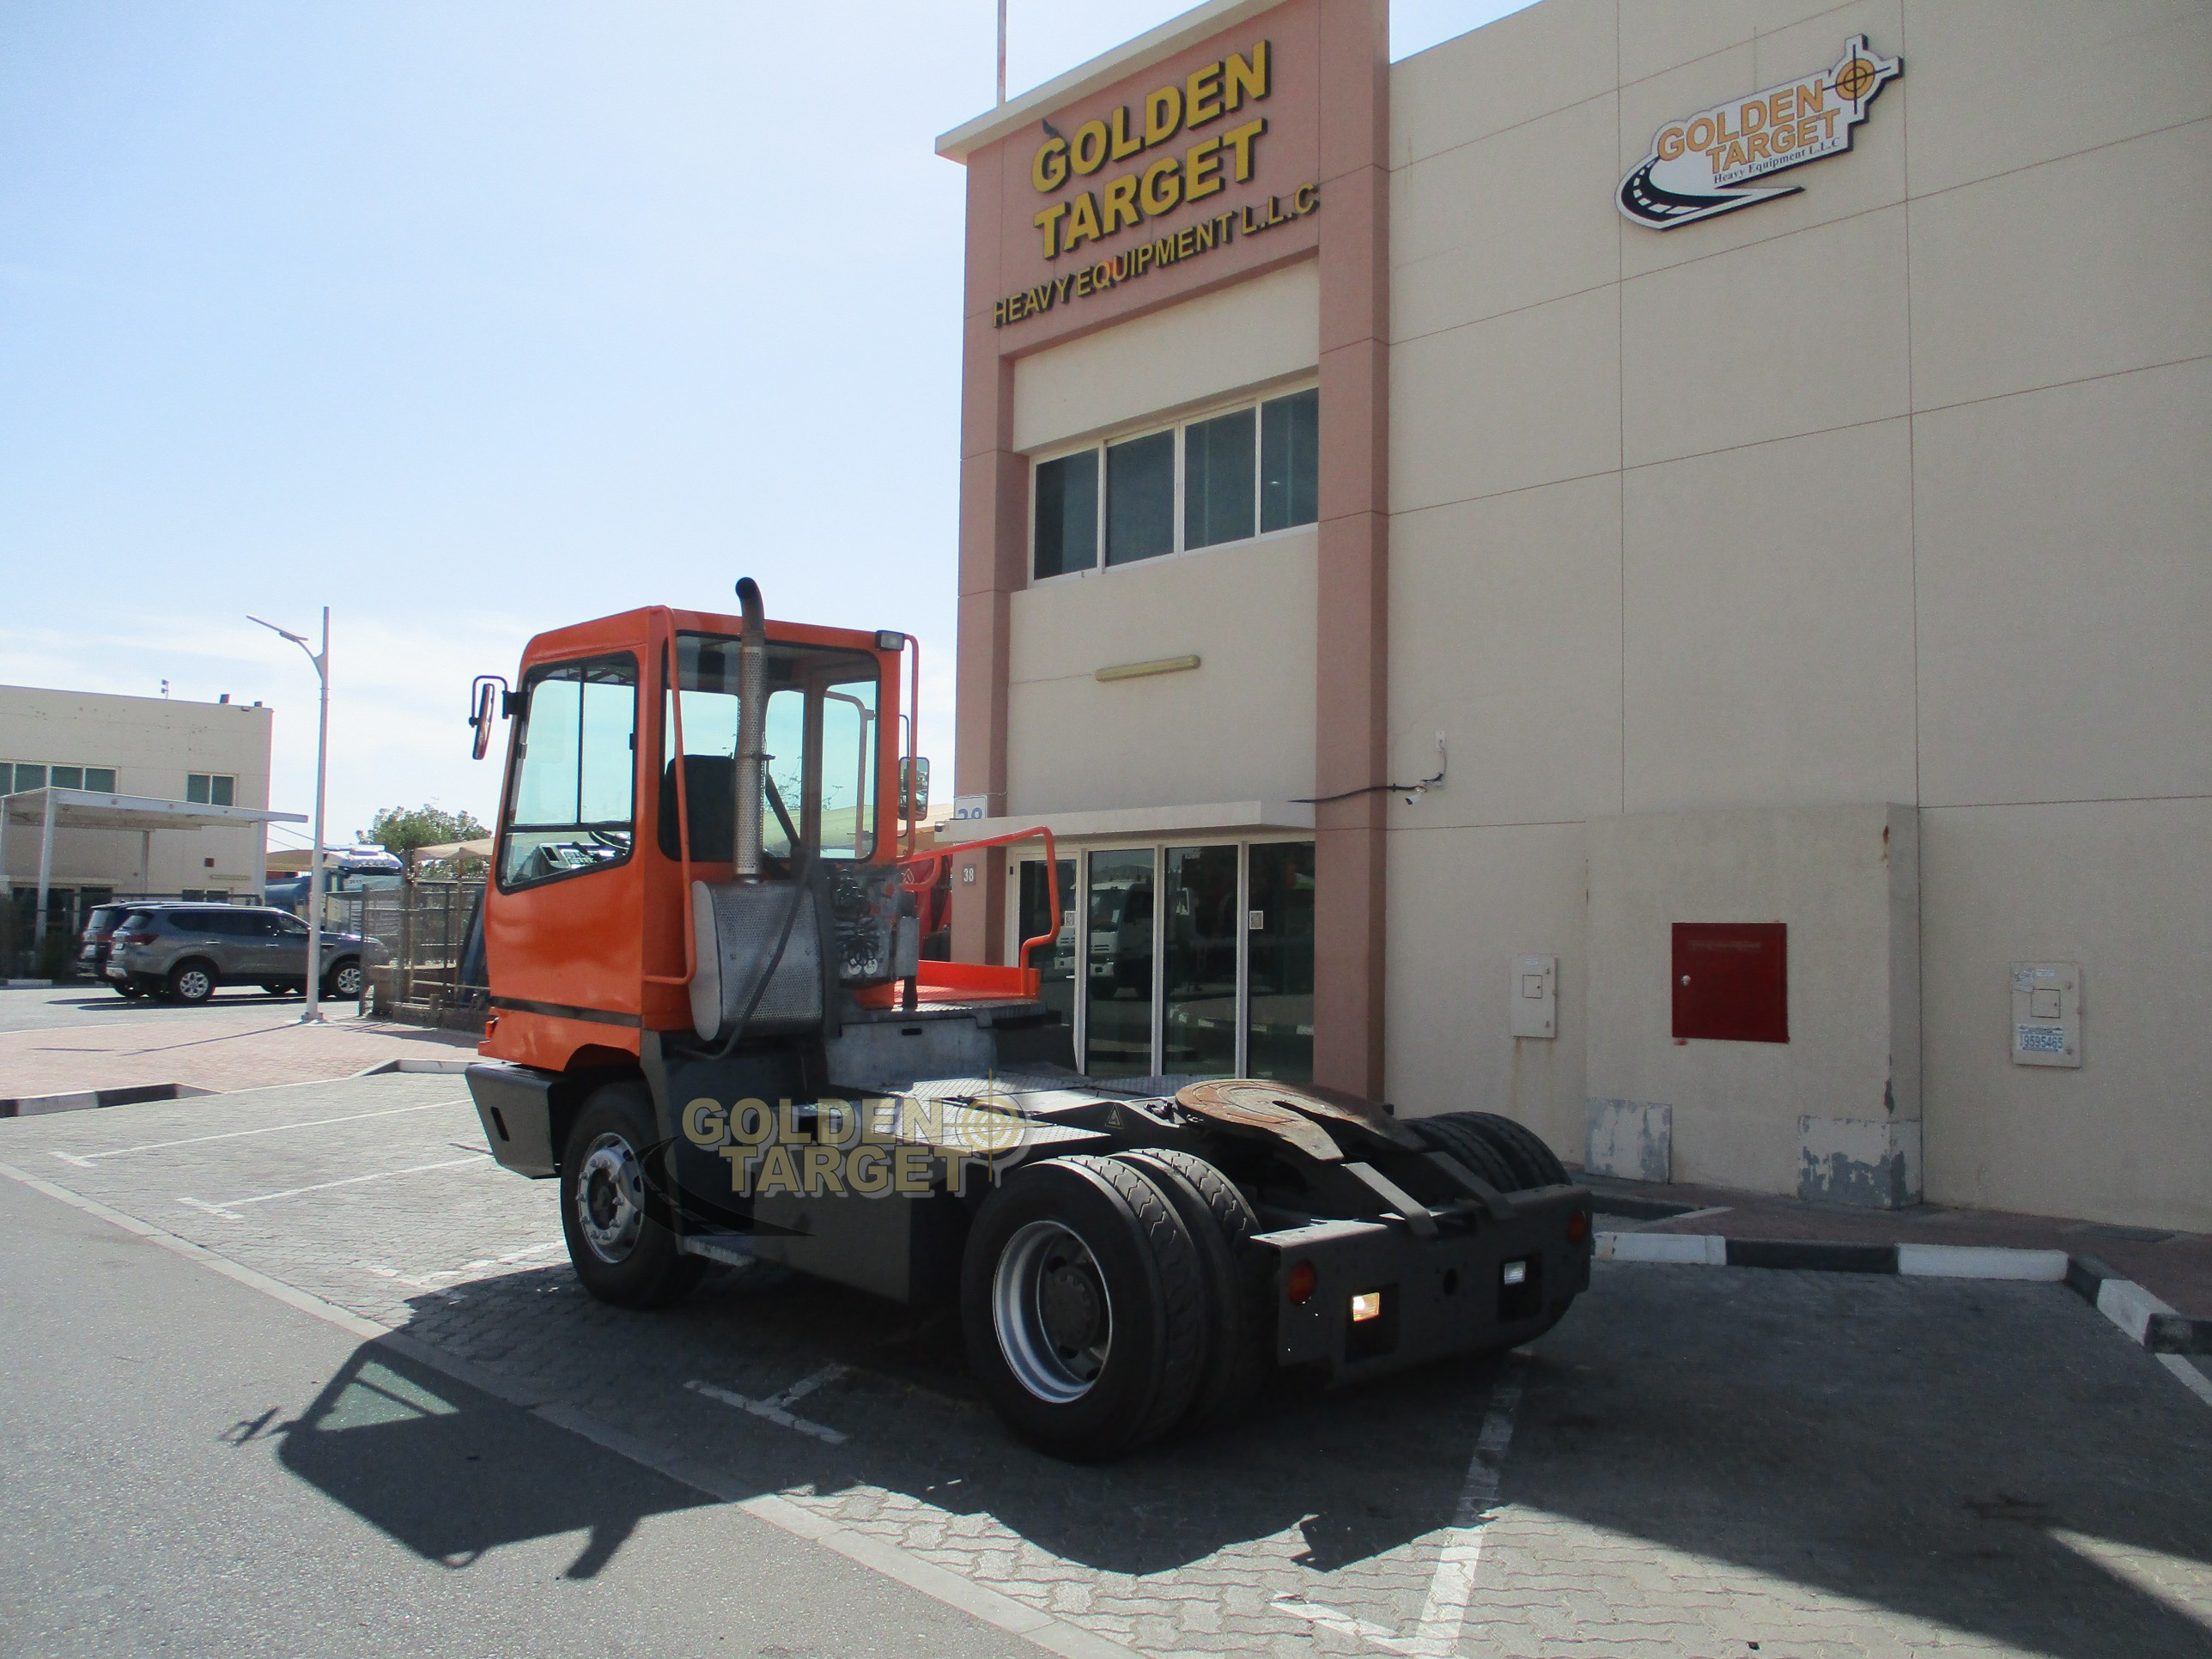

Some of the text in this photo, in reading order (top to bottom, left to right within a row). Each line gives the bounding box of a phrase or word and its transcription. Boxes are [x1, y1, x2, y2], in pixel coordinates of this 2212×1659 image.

[1031, 40, 1272, 194] GOLDEN
[1657, 78, 1824, 161] GOLDEN
[1705, 108, 1841, 174] TARGET
[1034, 118, 1267, 260] TARGET
[1714, 168, 1746, 184] Heavy
[1748, 149, 1805, 173] Equipment
[993, 183, 1321, 328] HEAVY EQUIPMENT L.L.C
[963, 867, 974, 883] 38
